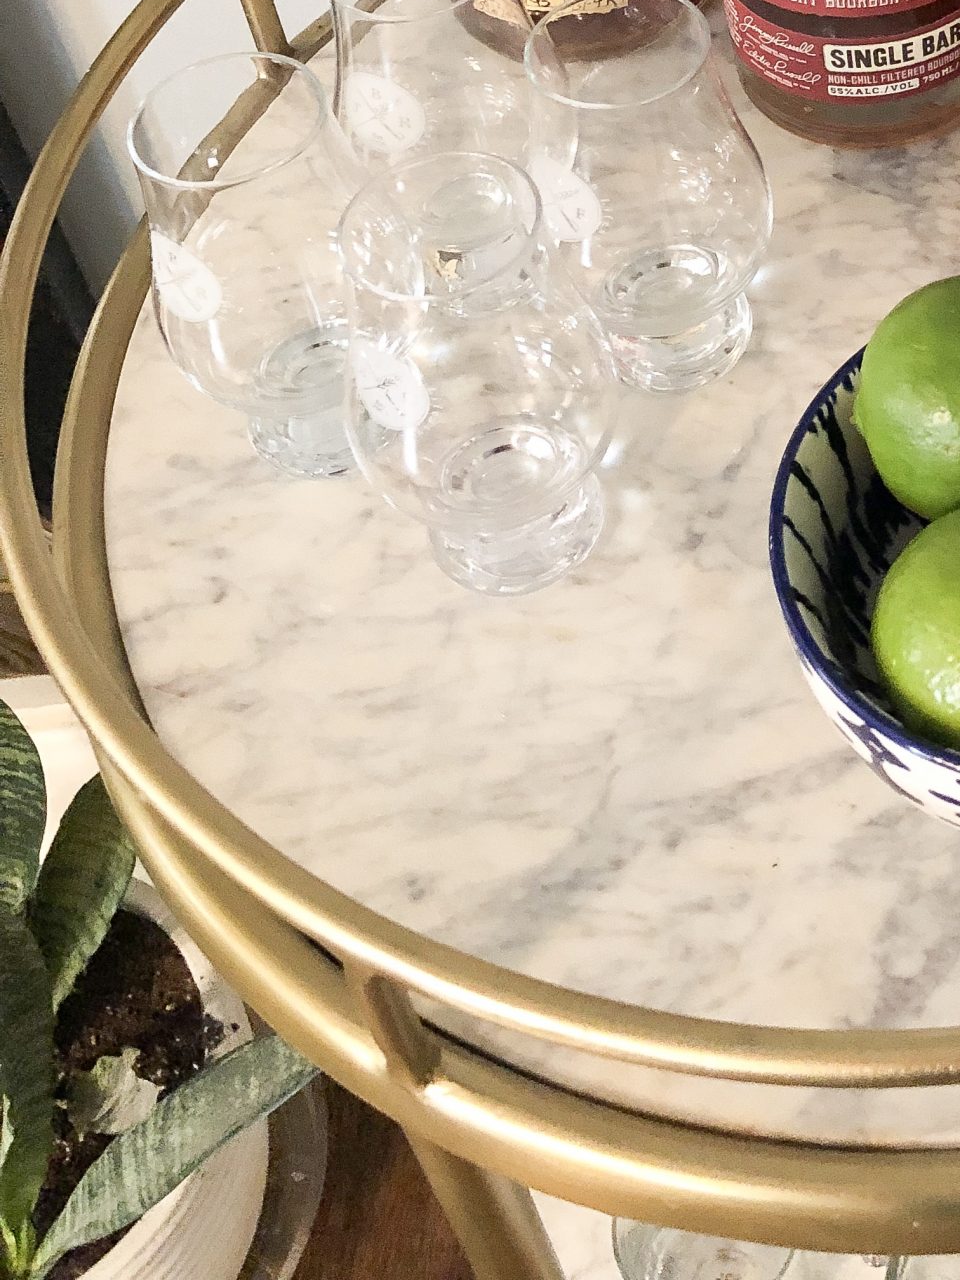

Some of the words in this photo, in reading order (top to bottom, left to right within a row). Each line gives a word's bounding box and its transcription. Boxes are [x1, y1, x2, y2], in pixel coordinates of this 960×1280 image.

[830, 41, 915, 69] SINGLE
[827, 74, 879, 85] NON-CHILL
[880, 64, 926, 83] FILTERED
[922, 72, 941, 84] 750
